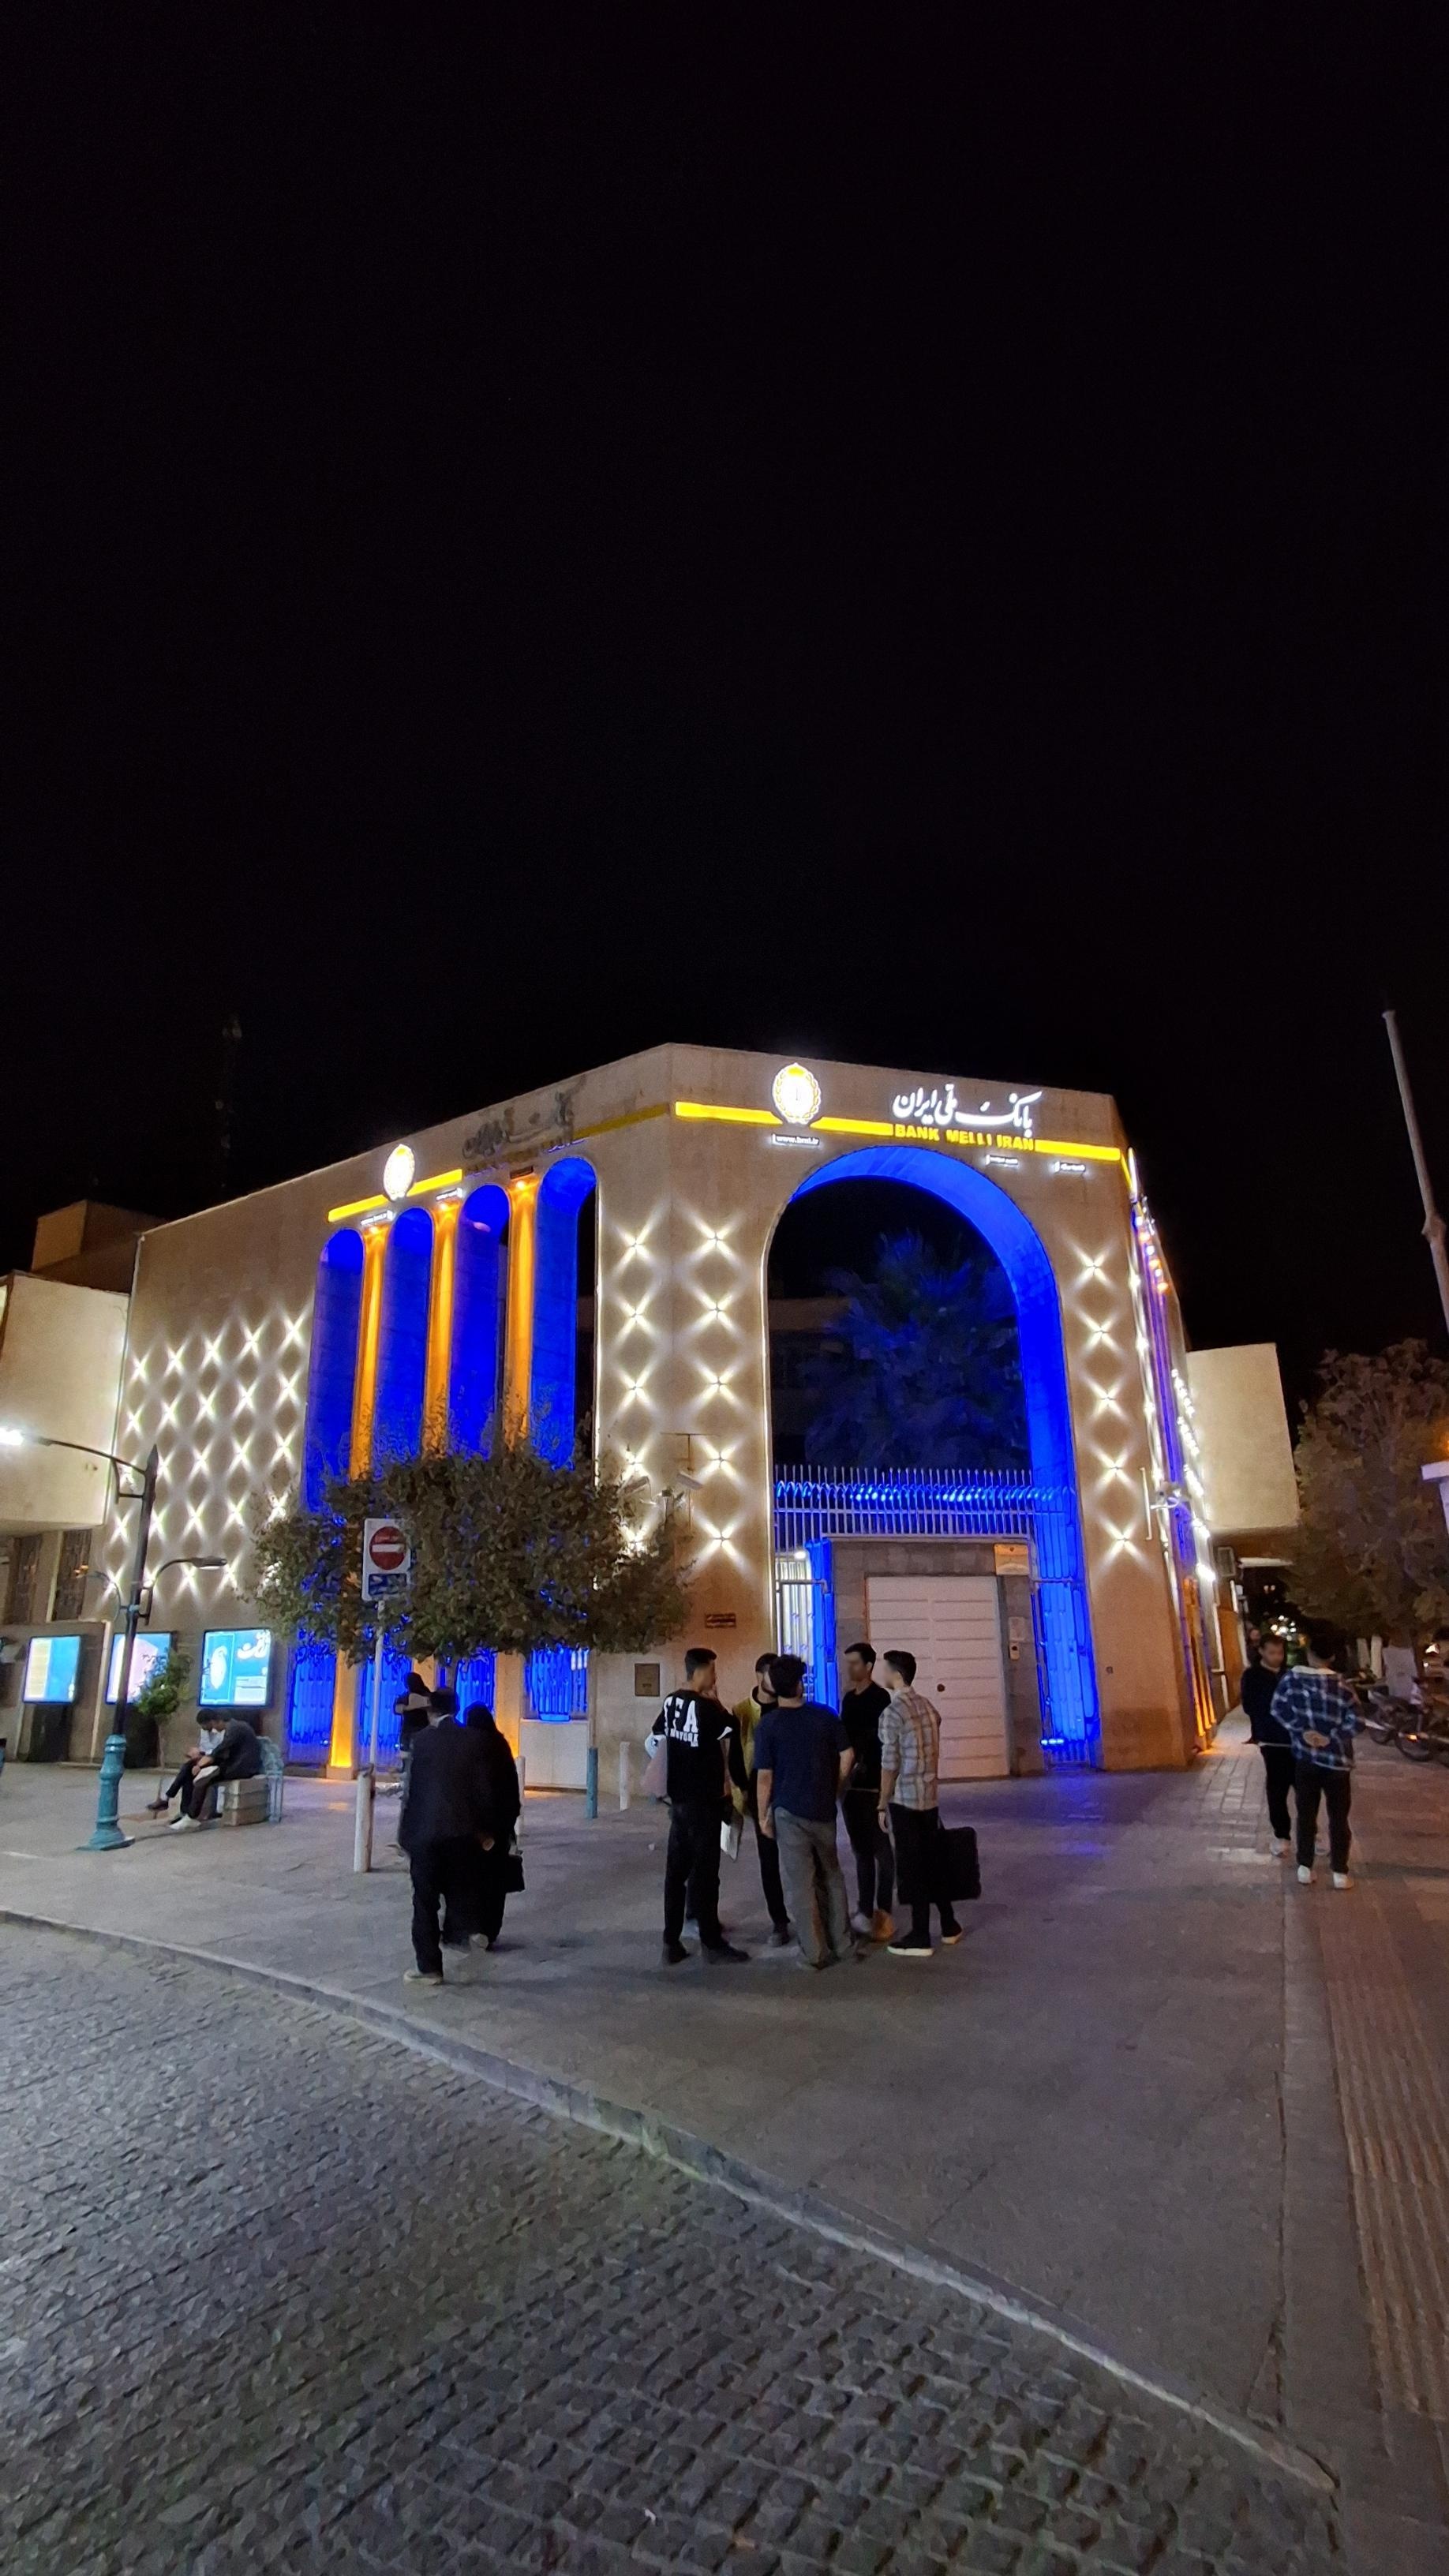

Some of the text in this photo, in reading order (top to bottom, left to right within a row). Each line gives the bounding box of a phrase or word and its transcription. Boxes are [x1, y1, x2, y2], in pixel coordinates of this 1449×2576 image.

[893, 1088, 938, 1125] ایران
[955, 1091, 1043, 1138] بانک
[894, 1123, 1034, 1151] BANK MELLI IRAN
